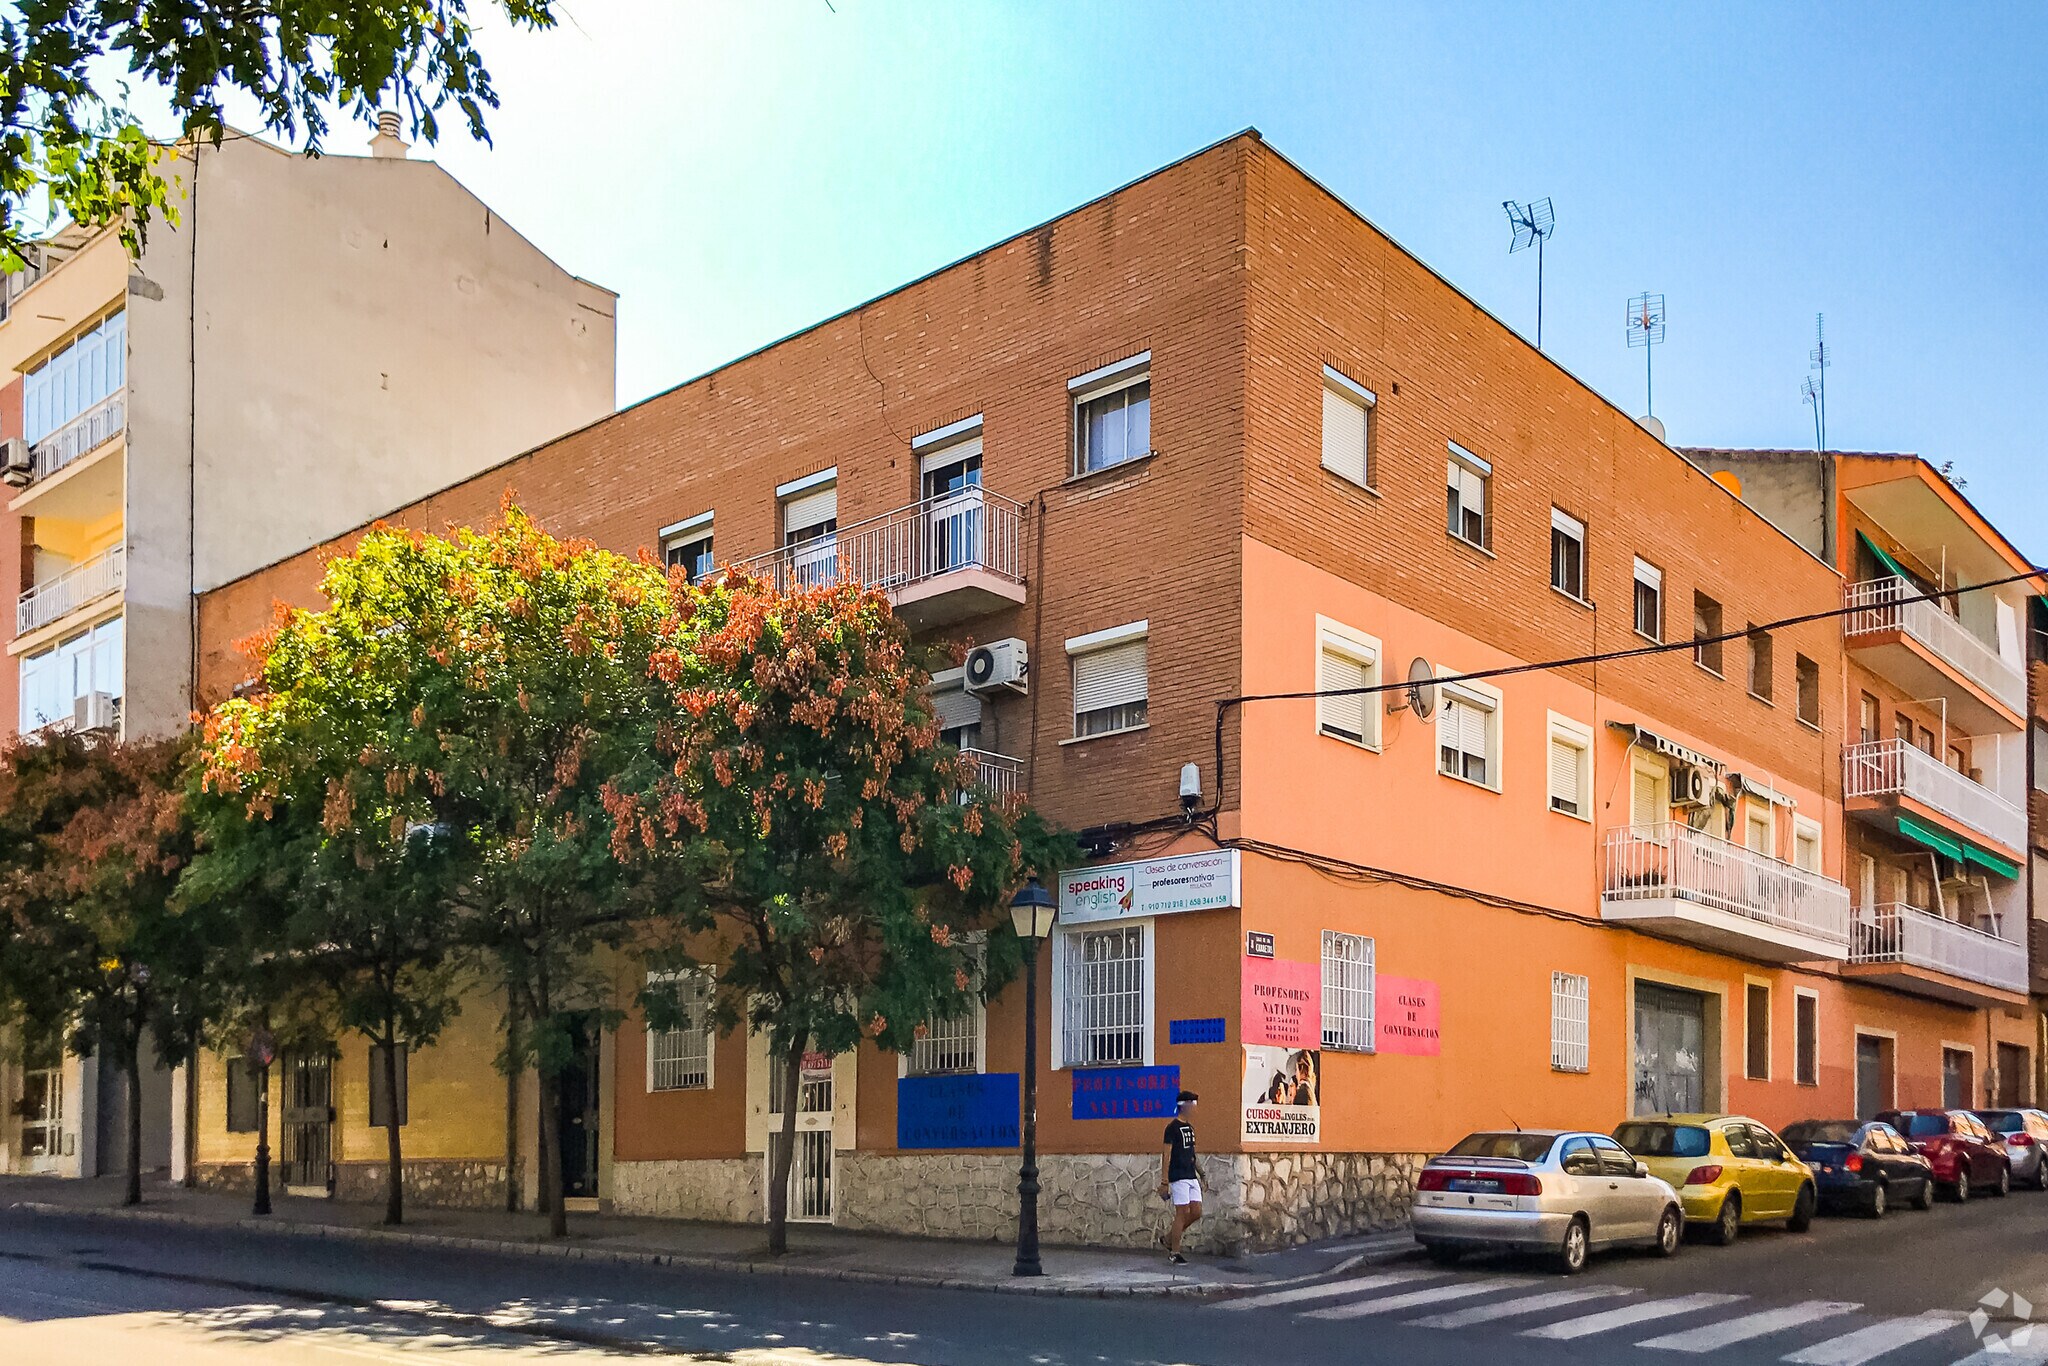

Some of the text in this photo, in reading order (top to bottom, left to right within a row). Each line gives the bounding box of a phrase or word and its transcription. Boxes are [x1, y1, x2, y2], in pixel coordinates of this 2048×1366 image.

[1145, 864, 1166, 875] Clases
[1167, 862, 1177, 872] de
[1068, 876, 1125, 895] speaking
[1075, 891, 1117, 909] english
[1254, 984, 1310, 1001] PROFESORES
[1398, 995, 1426, 1008] CLASES
[1262, 1002, 1302, 1017] NATIVOS
[1407, 1011, 1417, 1022] DE
[1383, 1025, 1439, 1040] CONVERSACION
[1246, 1108, 1281, 1120] CURSOS
[1245, 1121, 1316, 1136] EXTRANJERO
